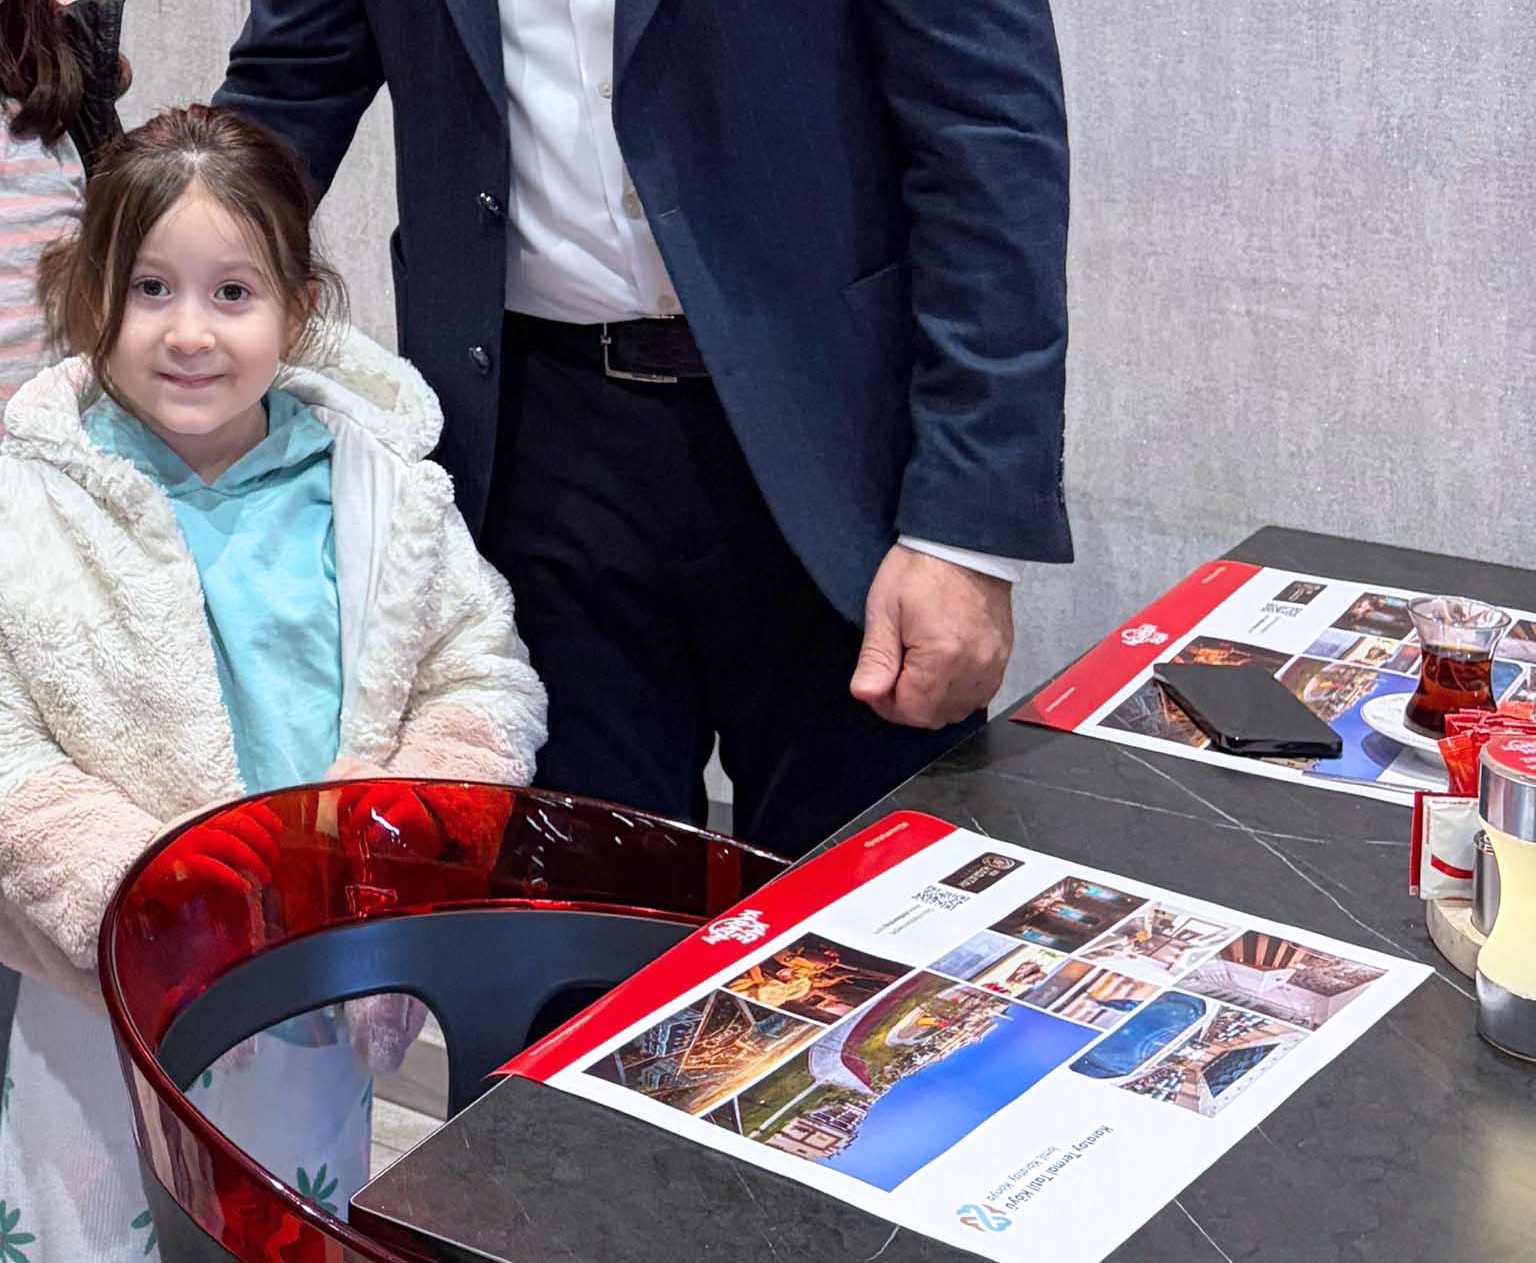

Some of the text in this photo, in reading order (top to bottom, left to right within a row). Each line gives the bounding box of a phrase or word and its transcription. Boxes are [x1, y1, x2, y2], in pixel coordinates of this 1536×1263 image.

[1072, 1124, 1114, 1152] Karatay
[1045, 1152, 1082, 1176] Termal
[1026, 1174, 1054, 1192] Tatil
